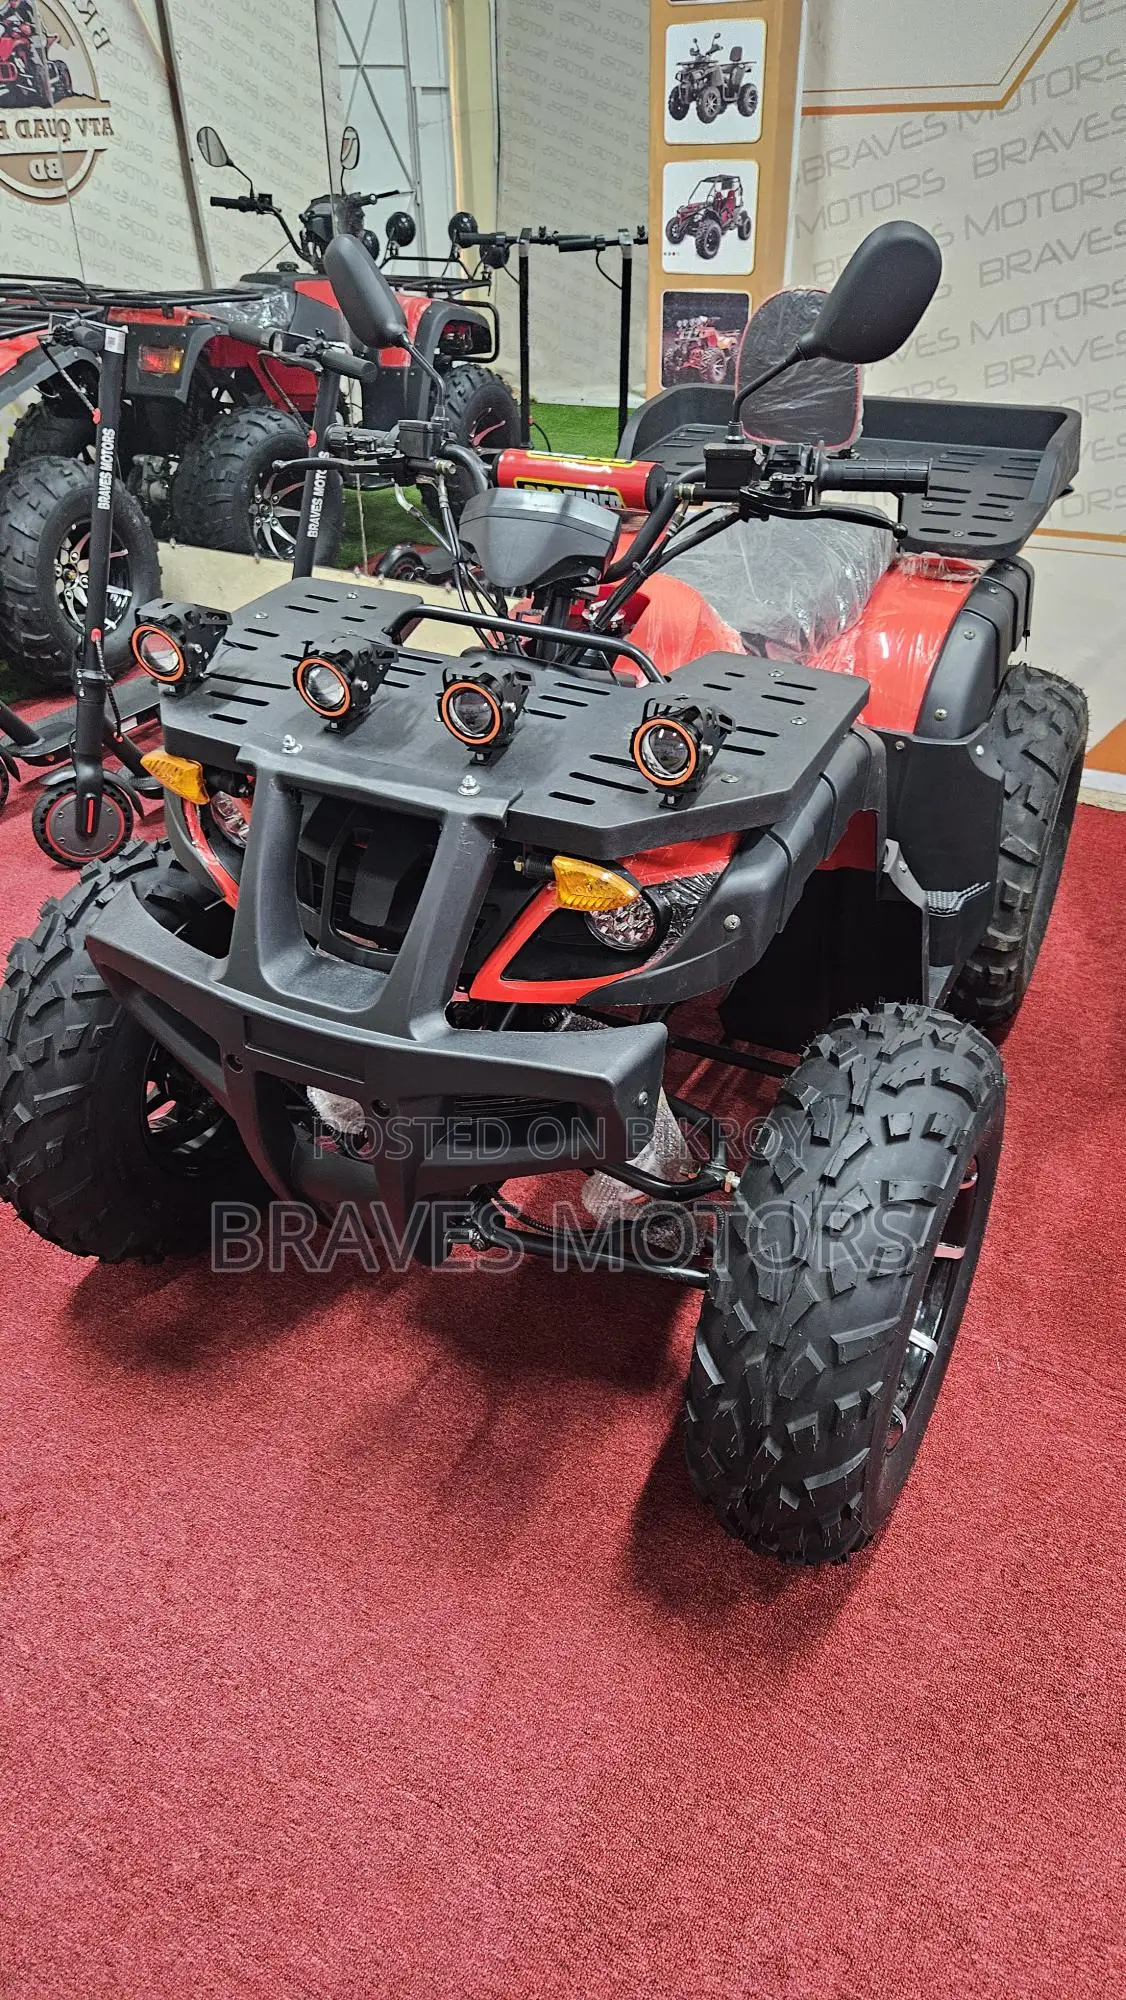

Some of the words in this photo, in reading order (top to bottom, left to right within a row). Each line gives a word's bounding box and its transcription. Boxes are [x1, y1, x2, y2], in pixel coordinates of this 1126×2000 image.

[801, 113, 947, 186] BRAVES
[972, 104, 1126, 179] BRAVES
[964, 166, 1126, 240] MOTORS
[979, 218, 1126, 288] BRAVES
[969, 278, 1126, 346] MOTORS
[984, 329, 1126, 389] BRAVES
[100, 427, 116, 471] MOTORS
[312, 451, 330, 497] MOTOS
[97, 471, 112, 510] BRAVES
[307, 497, 323, 538] BRAVES
